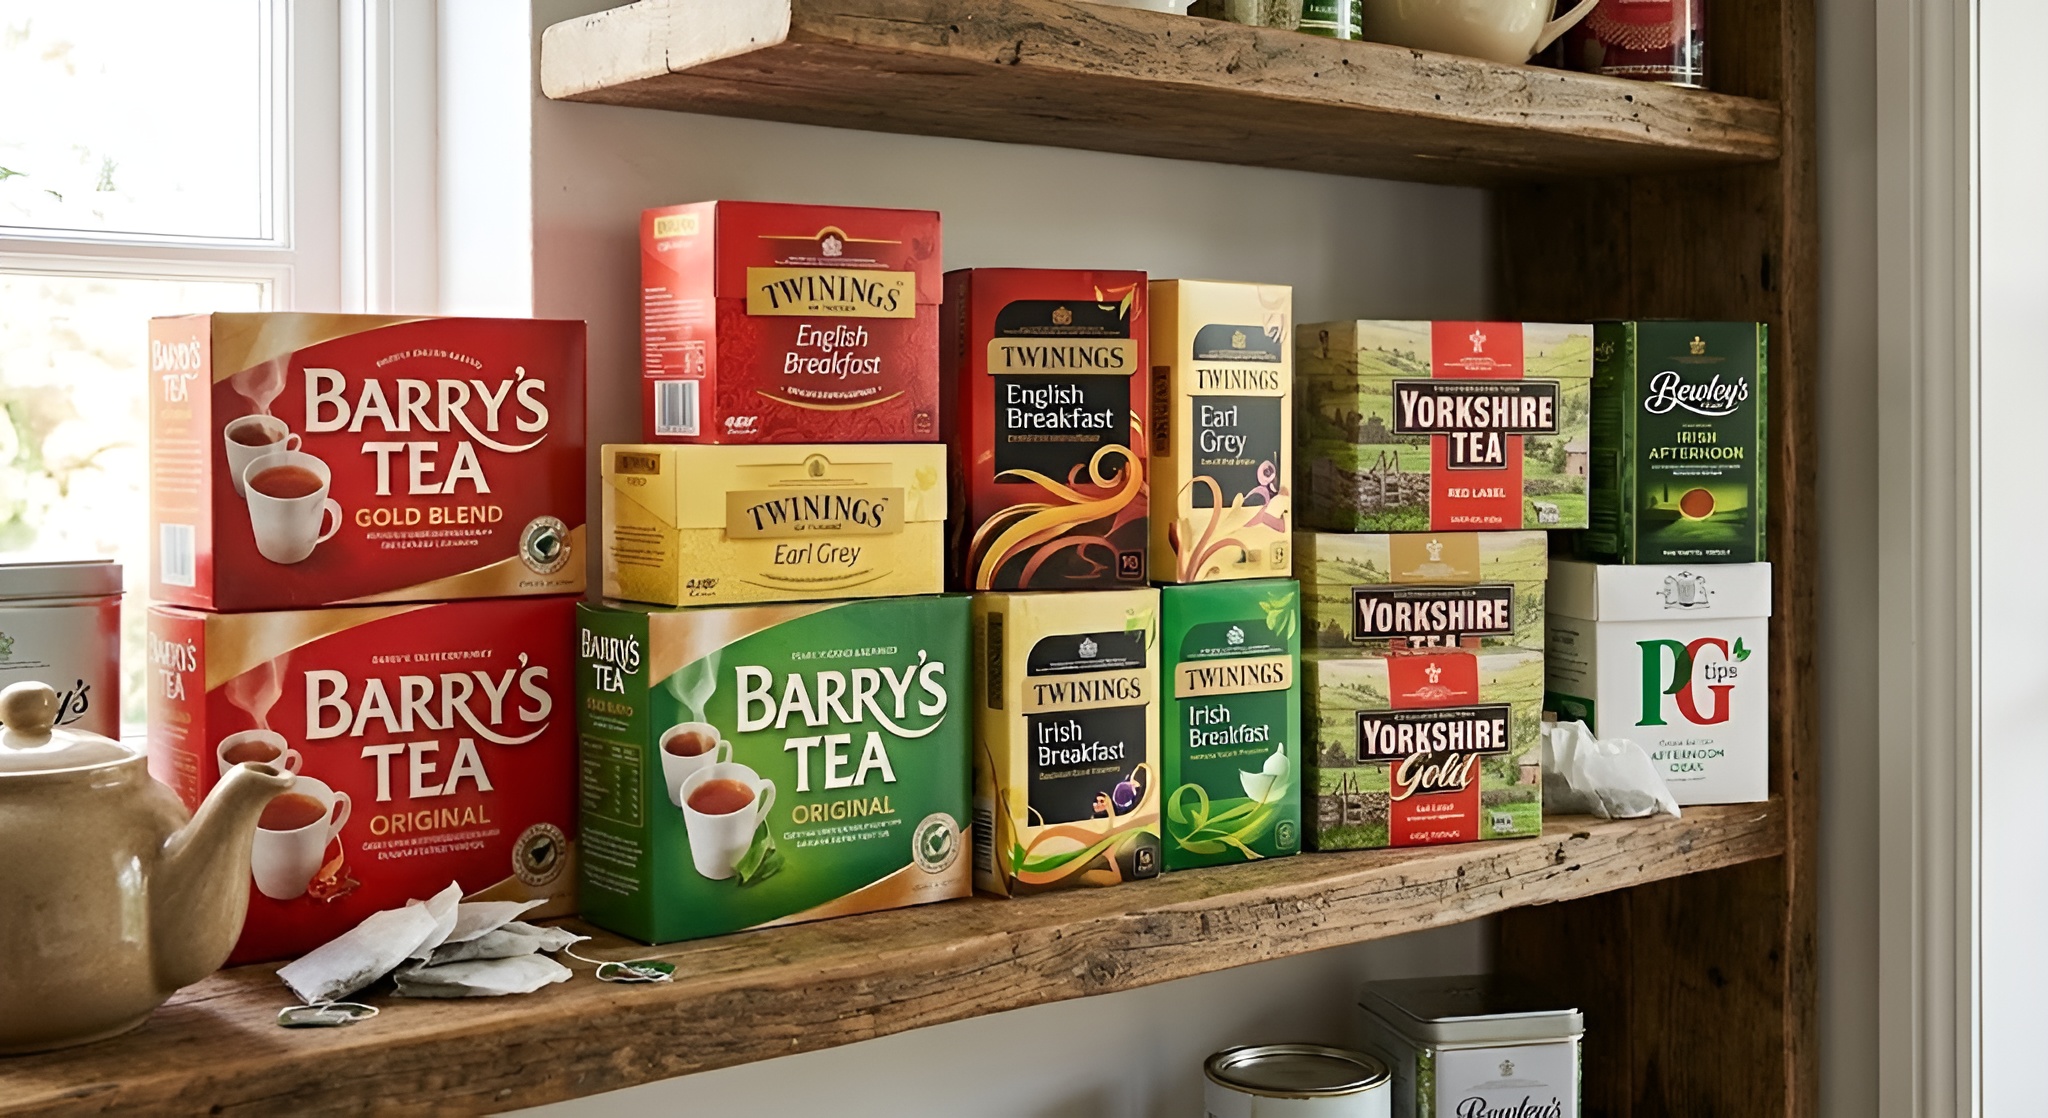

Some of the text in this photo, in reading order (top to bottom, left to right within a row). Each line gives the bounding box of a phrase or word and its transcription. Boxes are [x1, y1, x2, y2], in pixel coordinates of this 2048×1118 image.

[762, 274, 900, 312] TWININGS
[796, 324, 868, 353] English
[1001, 345, 1125, 369] TWININGS
[1196, 369, 1279, 390] TWININGS
[1644, 370, 1749, 416] Bewley's
[303, 366, 550, 453] BARRY'S
[1006, 384, 1084, 409] English
[1400, 390, 1553, 428] YORKSHIRE
[1006, 408, 1114, 430] Breakfast
[1201, 405, 1238, 428] Earl
[1200, 430, 1247, 458] Grey
[1452, 432, 1502, 463] TEA
[361, 441, 491, 496] TEA
[355, 505, 503, 528] GOLD BLEND
[746, 494, 885, 531] TWININGS
[774, 542, 861, 567] Earl Grey
[1359, 598, 1509, 632] YORKSHIRE
[592, 663, 625, 694] TEA
[1033, 677, 1141, 706] TWININGS
[1185, 662, 1284, 690] TWININGS
[1635, 637, 1738, 727] PG tips
[304, 652, 552, 745] BARRY'S
[734, 649, 949, 738] BARRY'S
[1189, 703, 1231, 727] Irish
[1038, 719, 1082, 745] Irish
[1189, 723, 1270, 749] Breakfast
[1363, 719, 1506, 754] YORKSHIRE
[783, 731, 897, 792] TEA
[1038, 741, 1125, 767] Breakfast
[360, 738, 494, 802] TEA
[1389, 752, 1479, 801] Gold
[369, 804, 492, 836] ORIGINAL
[791, 796, 896, 826] ORIGINAL
